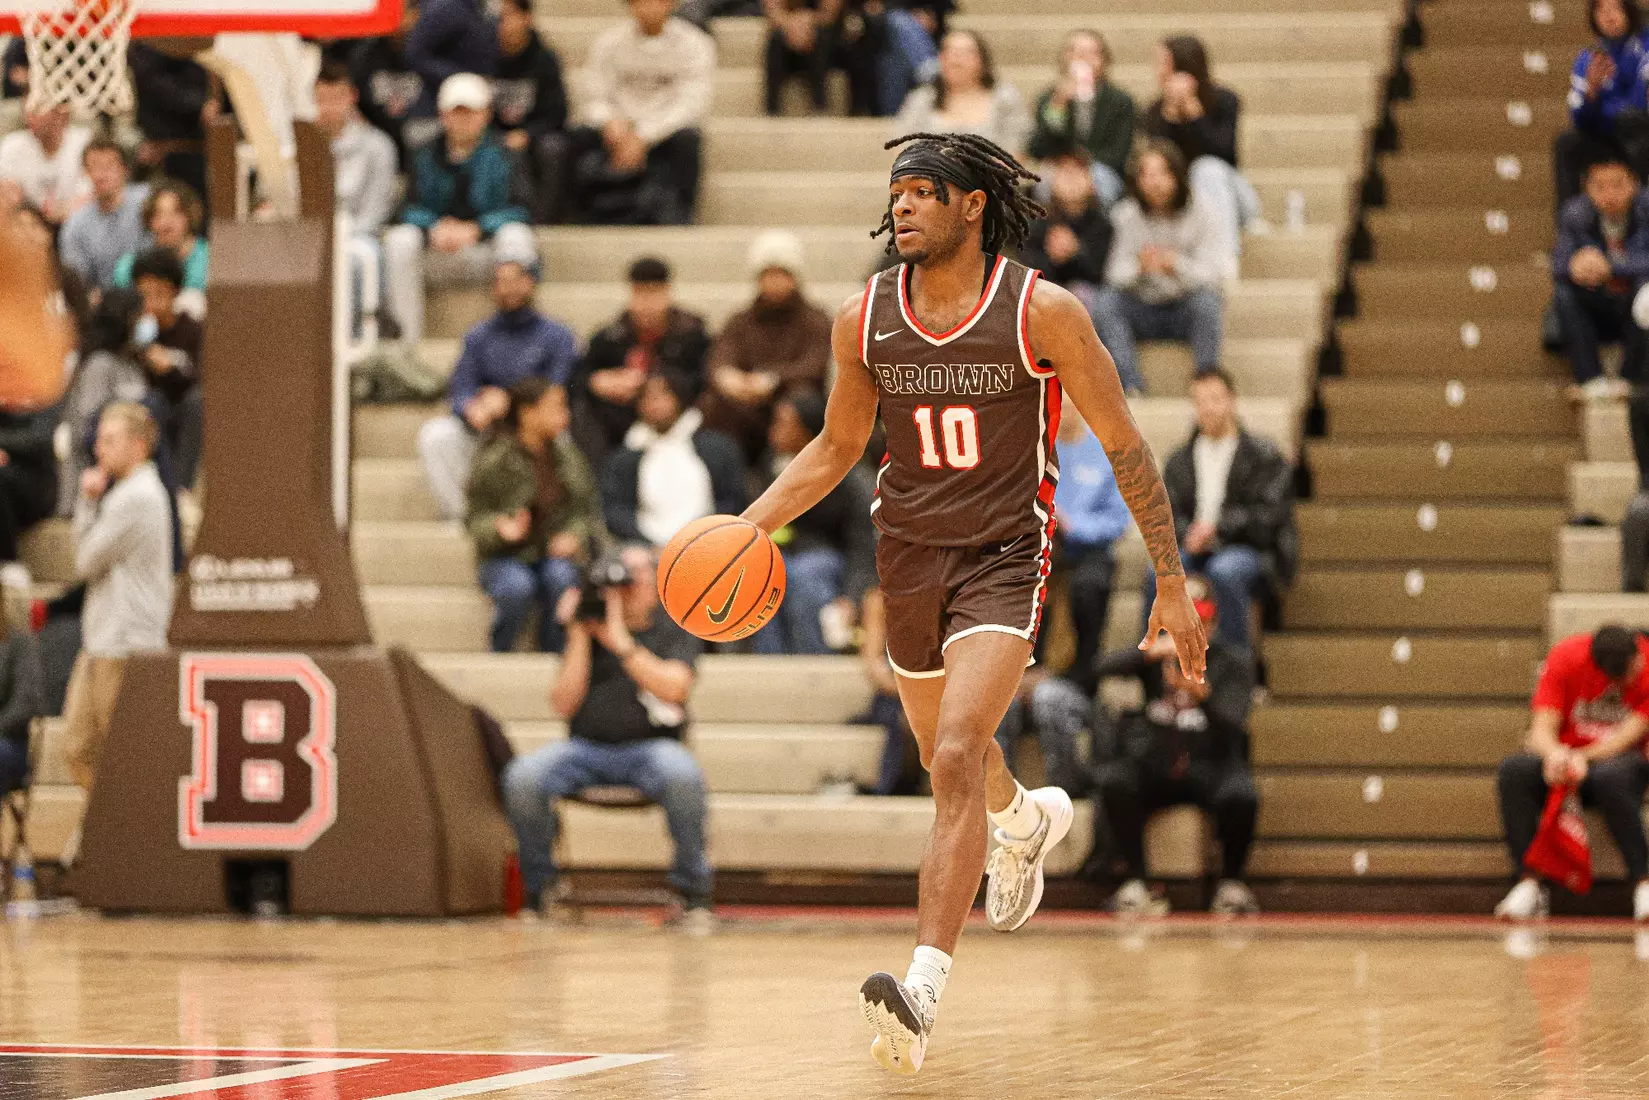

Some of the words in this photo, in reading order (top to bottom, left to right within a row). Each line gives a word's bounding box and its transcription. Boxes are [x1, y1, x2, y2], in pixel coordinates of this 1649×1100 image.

[875, 364, 1015, 394] BROWN
[912, 405, 981, 470] 10
[732, 586, 781, 637] ELITE
[178, 652, 338, 850] B
